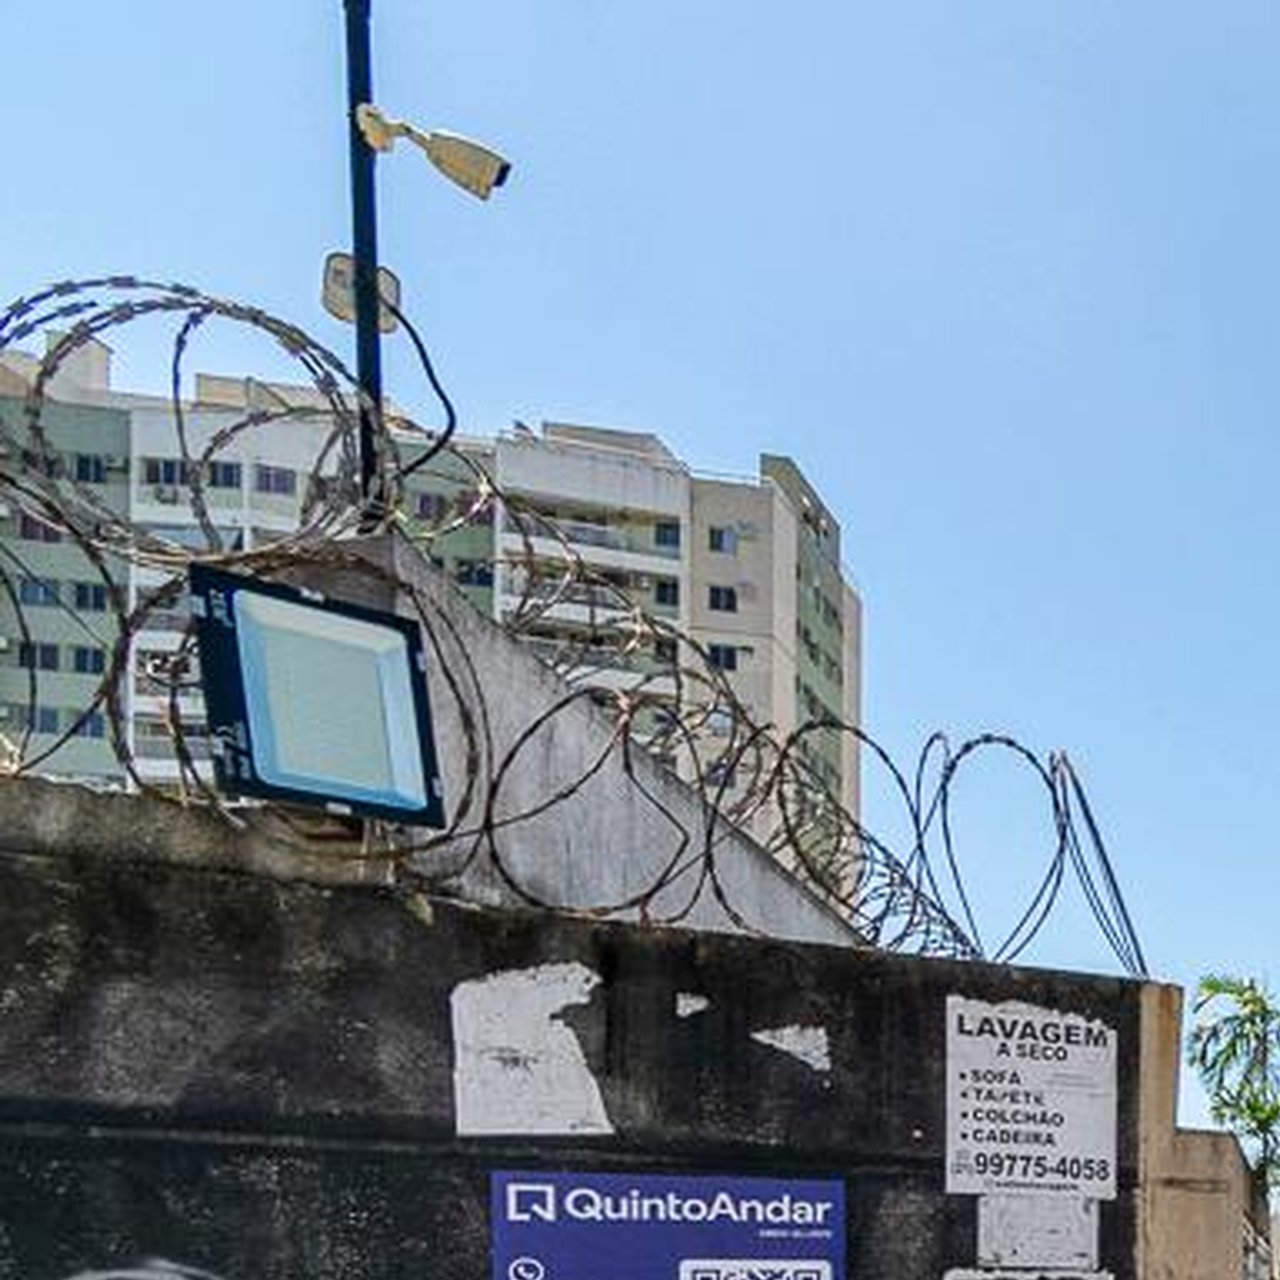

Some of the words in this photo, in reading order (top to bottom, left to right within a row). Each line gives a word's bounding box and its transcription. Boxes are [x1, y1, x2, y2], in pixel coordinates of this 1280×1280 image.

[957, 1013, 1108, 1048] LAVAGEM
[1016, 1043, 1068, 1061] SECO
[972, 1128, 1057, 1147] CADEIRA
[974, 1152, 1110, 1182] 99775-4058
[564, 1188, 833, 1225] QuintoAndar
